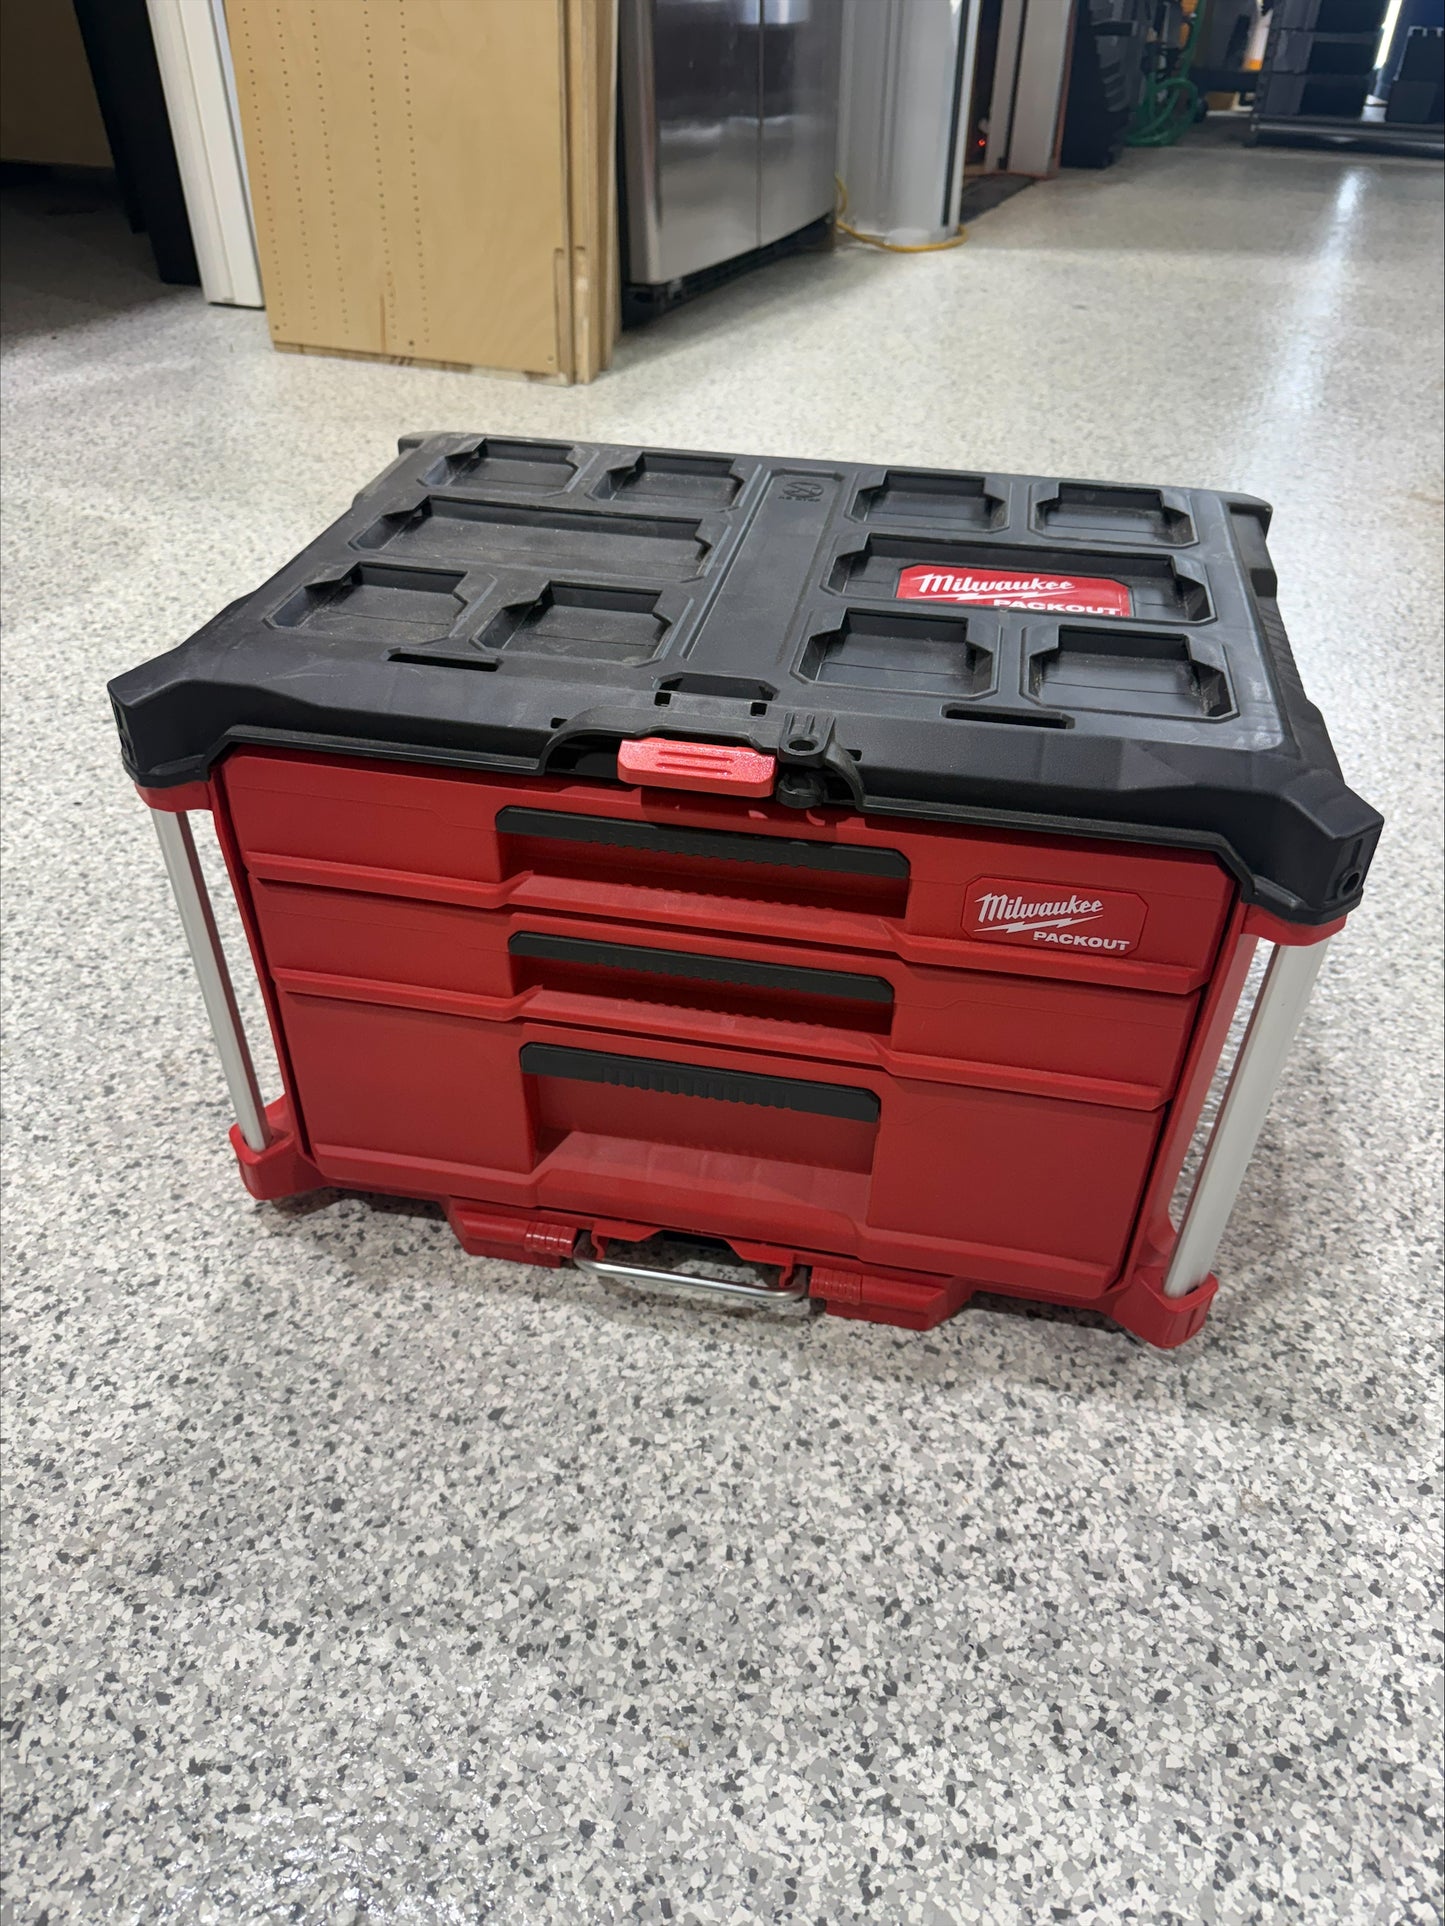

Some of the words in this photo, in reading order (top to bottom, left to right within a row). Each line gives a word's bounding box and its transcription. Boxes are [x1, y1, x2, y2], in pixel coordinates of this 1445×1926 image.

[910, 573, 1075, 593] Milwaukee
[993, 599, 1121, 616] PACKOUT
[974, 892, 1104, 923] Milwaukee
[1033, 931, 1130, 950] PACKOUT
